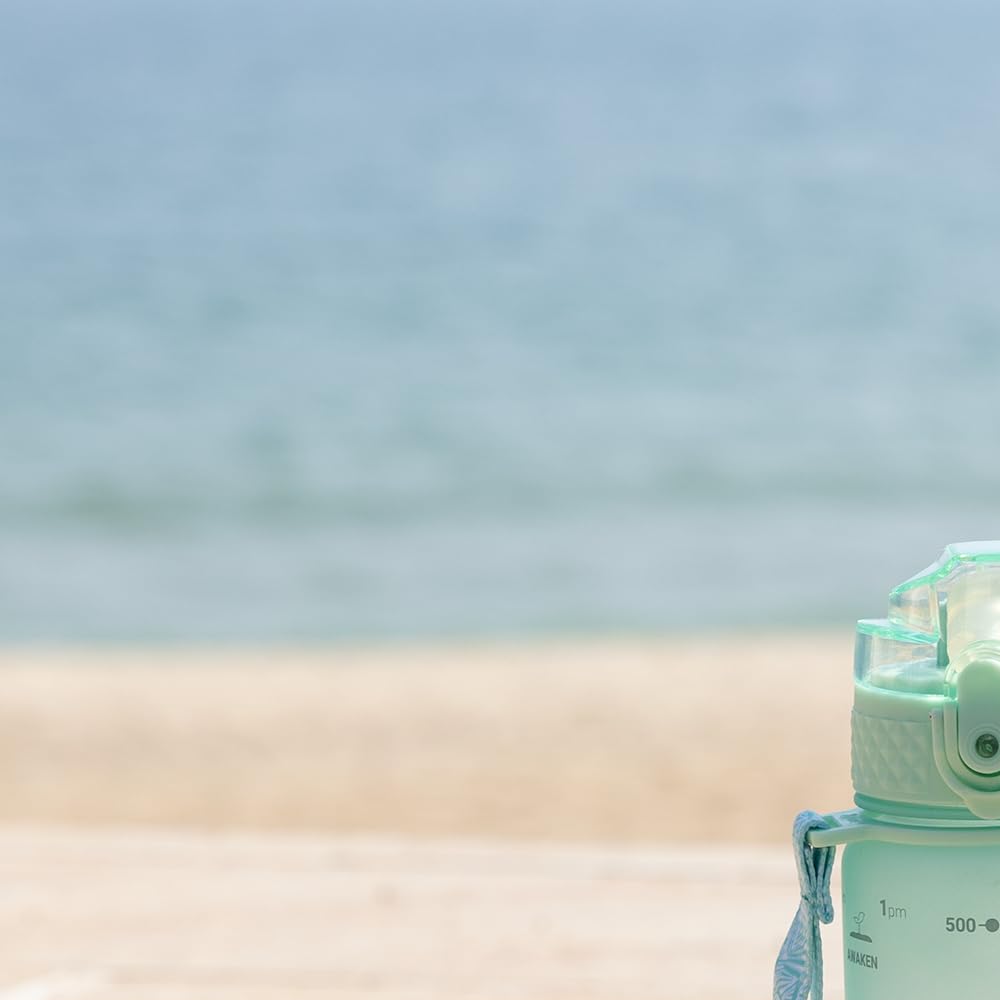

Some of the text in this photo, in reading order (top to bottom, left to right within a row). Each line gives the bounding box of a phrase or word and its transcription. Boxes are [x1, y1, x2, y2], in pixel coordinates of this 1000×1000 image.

[879, 899, 907, 920] 1pm
[945, 917, 976, 932] 500
[847, 948, 878, 969] AWAKEN
